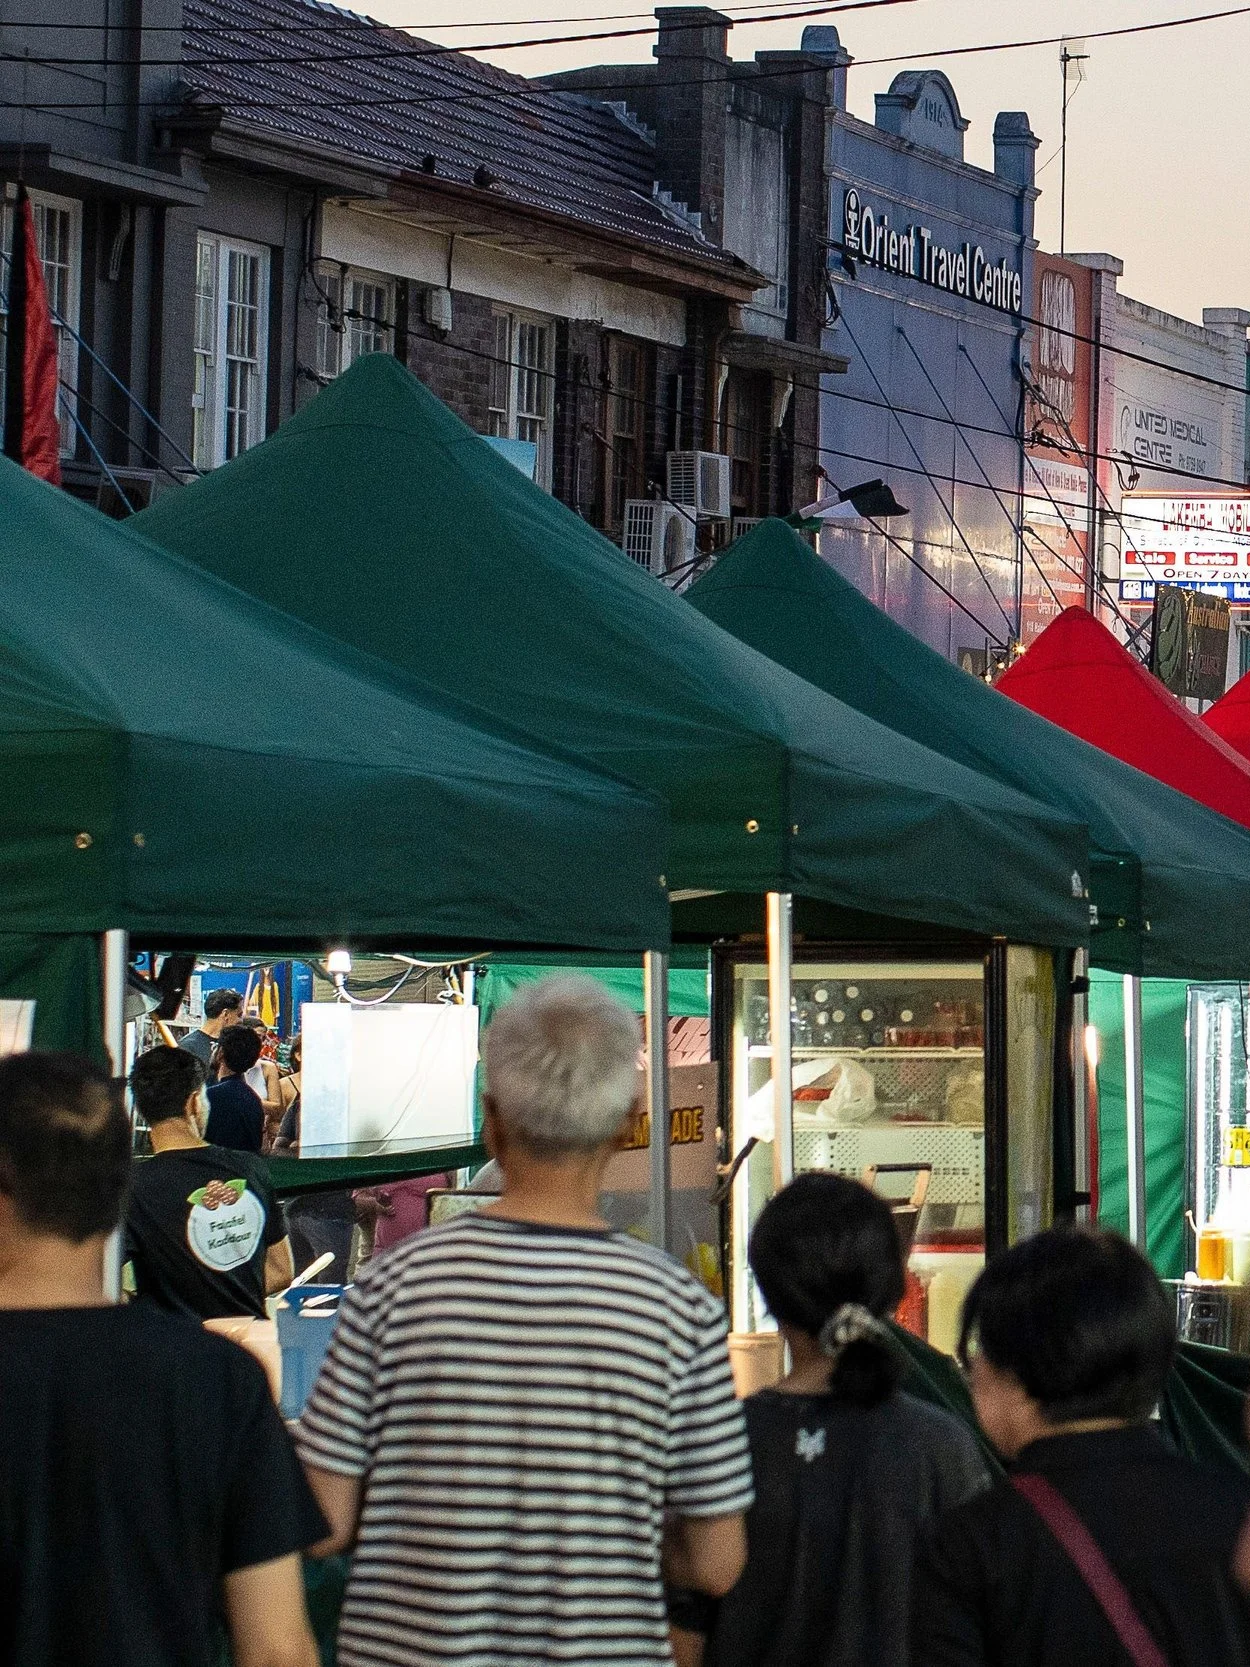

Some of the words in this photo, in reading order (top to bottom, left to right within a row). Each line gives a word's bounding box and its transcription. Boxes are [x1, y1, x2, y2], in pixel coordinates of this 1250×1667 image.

[861, 205, 916, 275] Orient
[920, 226, 970, 296] Travel
[974, 245, 1021, 312] Centre
[1134, 407, 1168, 436] UNITED
[1169, 418, 1207, 447] MEDICAL
[1133, 436, 1172, 464] CENTRE
[1163, 502, 1212, 532] LAKEMBA
[1134, 552, 1167, 564] Sale
[1188, 552, 1235, 565] Service
[1207, 569, 1220, 579] 7
[209, 1214, 246, 1233] Falafel
